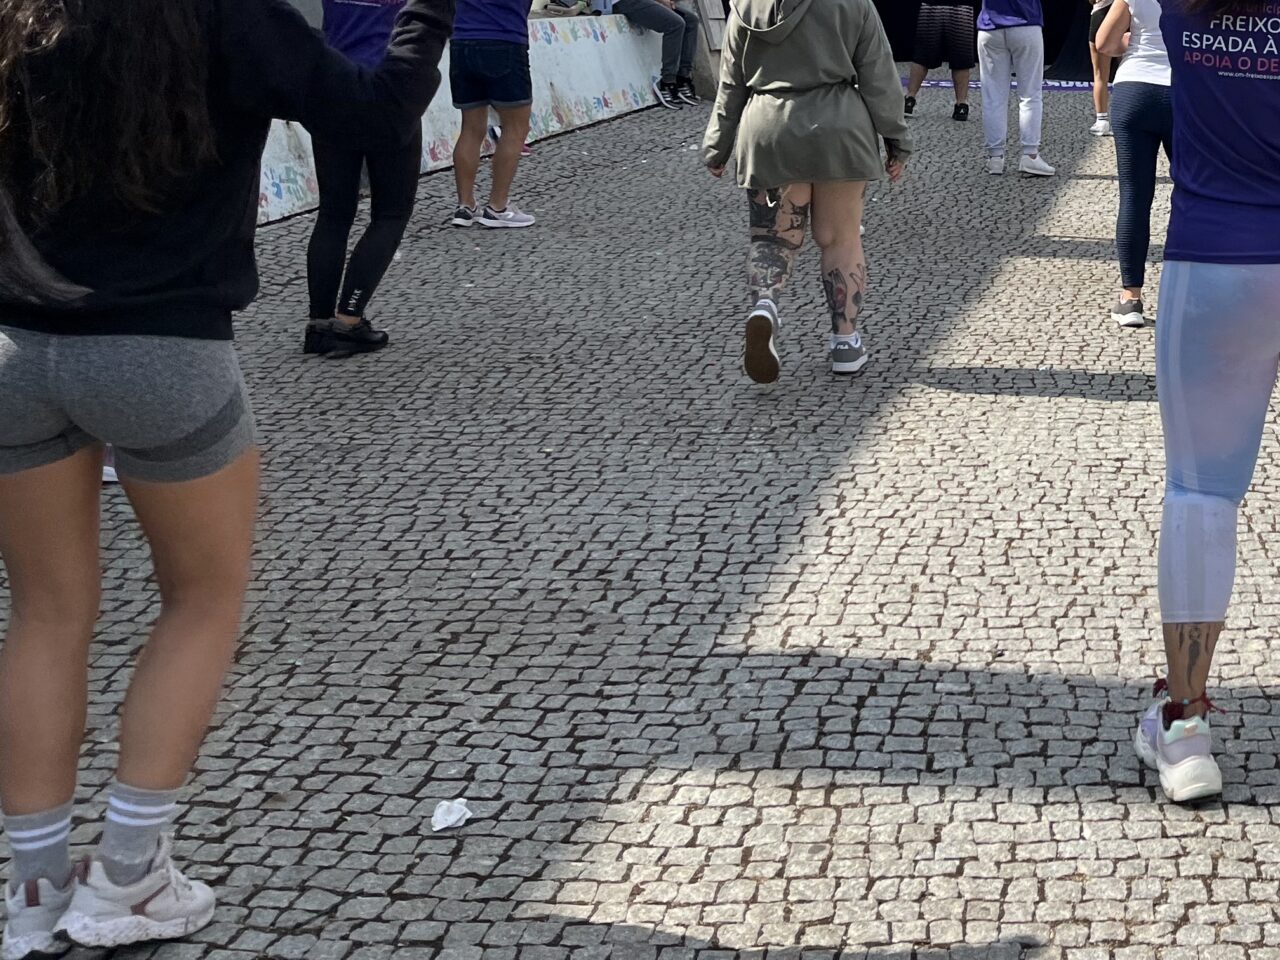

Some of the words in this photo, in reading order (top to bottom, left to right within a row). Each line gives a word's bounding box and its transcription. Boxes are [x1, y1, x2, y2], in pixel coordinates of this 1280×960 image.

[1182, 32, 1257, 54] ESPADA
[1263, 35, 1278, 55] À
[1184, 51, 1232, 69] APOIA
[1238, 56, 1251, 70] O
